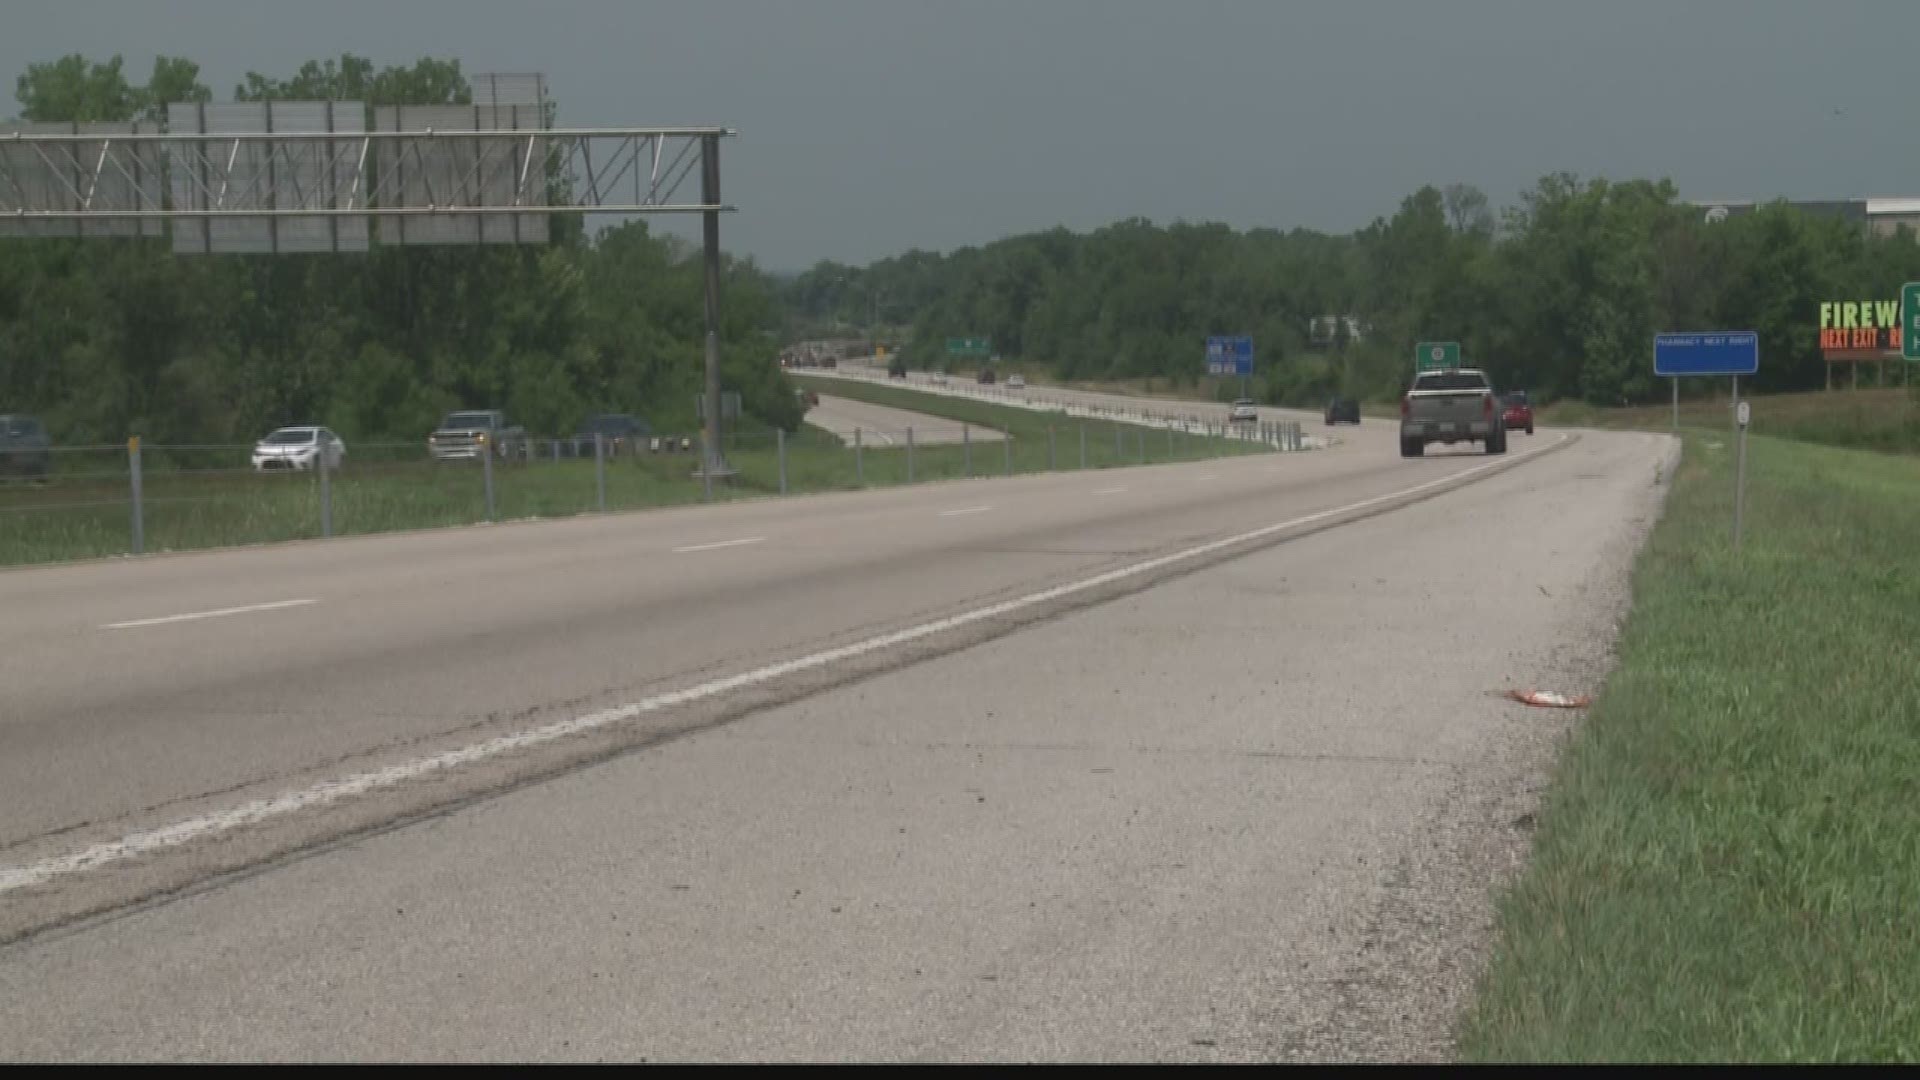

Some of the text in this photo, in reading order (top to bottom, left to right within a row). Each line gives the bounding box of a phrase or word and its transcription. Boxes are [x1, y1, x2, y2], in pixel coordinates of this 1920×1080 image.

[1820, 300, 1901, 329] FIREW
[1703, 335, 1726, 346] NEXT
[1820, 328, 1848, 348] NEXT
[1852, 328, 1878, 348] EXIT
